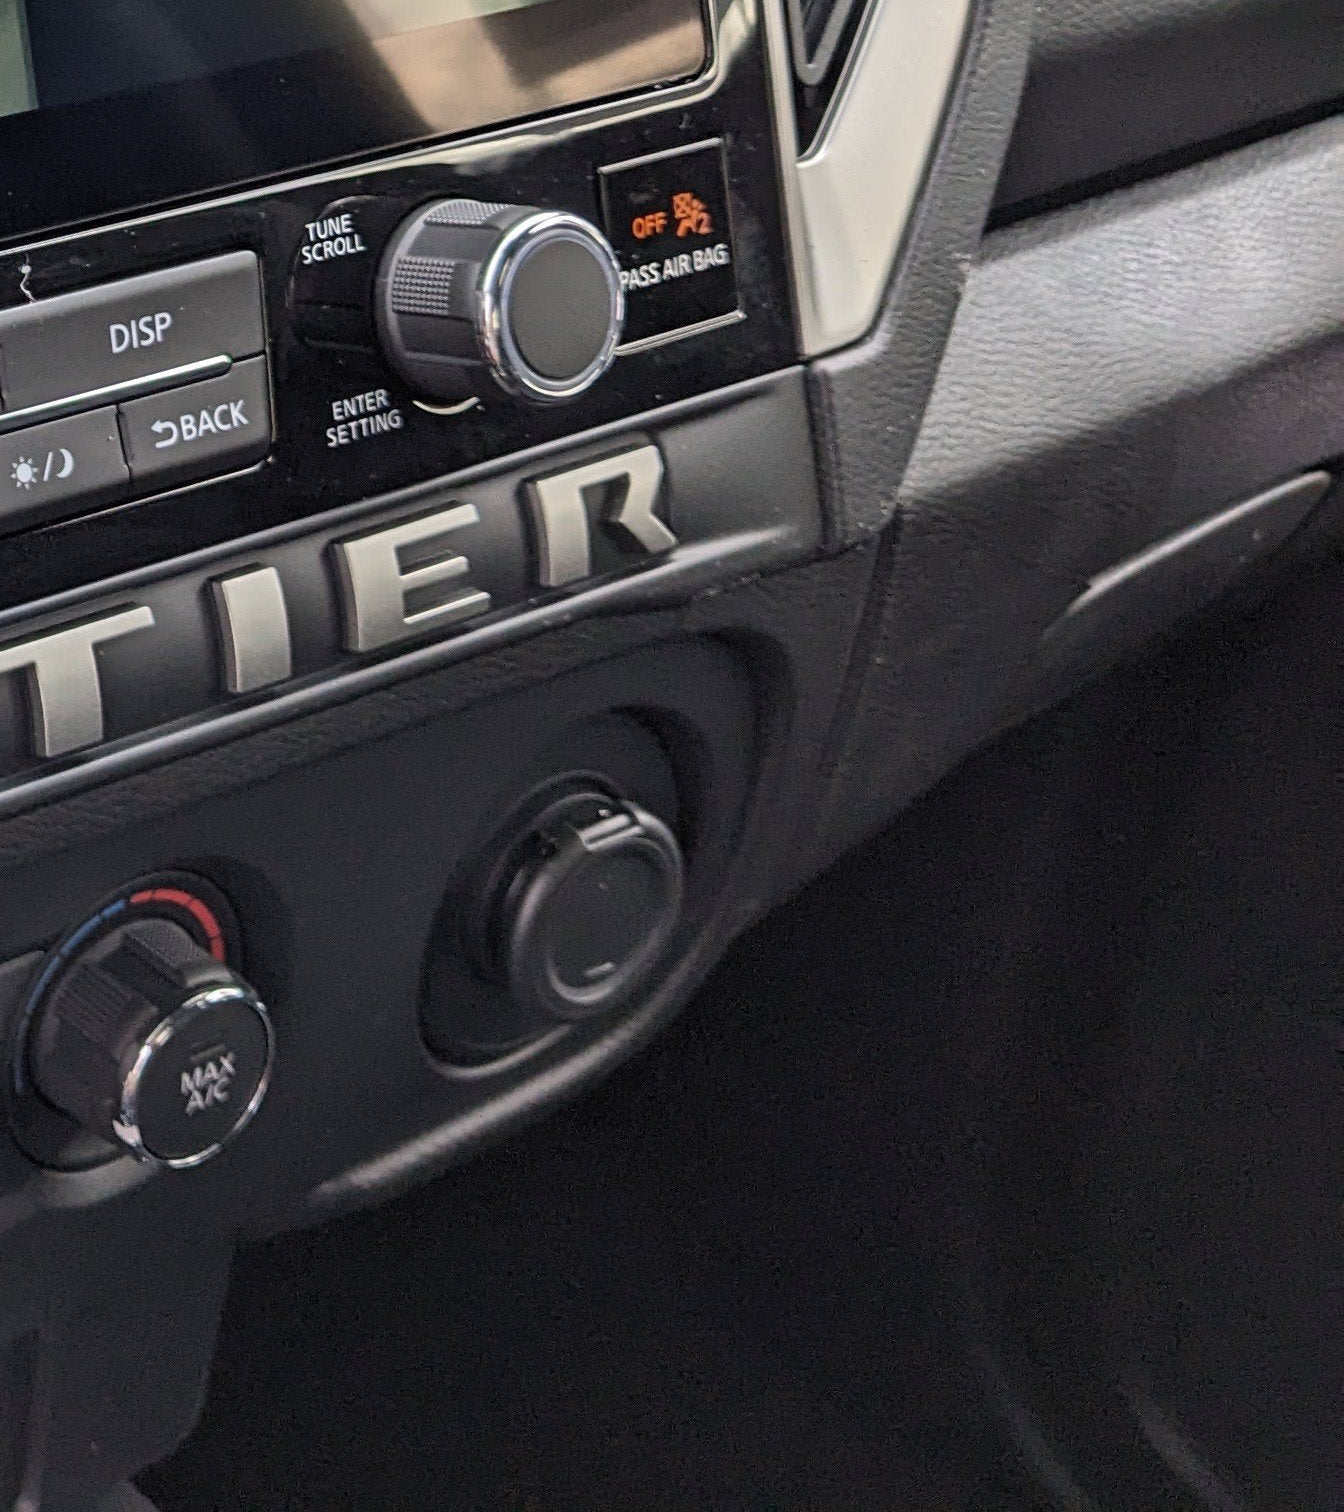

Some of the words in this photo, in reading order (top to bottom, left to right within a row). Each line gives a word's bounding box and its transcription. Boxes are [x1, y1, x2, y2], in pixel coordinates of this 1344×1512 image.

[304, 213, 354, 242] TUNE
[631, 211, 668, 239] OFF
[301, 233, 367, 266] SCROLL
[618, 261, 662, 291] PASS
[663, 253, 694, 281] AIR
[692, 242, 731, 272] BAG
[108, 312, 174, 354] DISP
[179, 399, 250, 442] BACK
[331, 388, 390, 421] ENTER
[325, 408, 405, 449] SETTING
[180, 1051, 236, 1096] MAX
[185, 1076, 230, 1117] A/C
